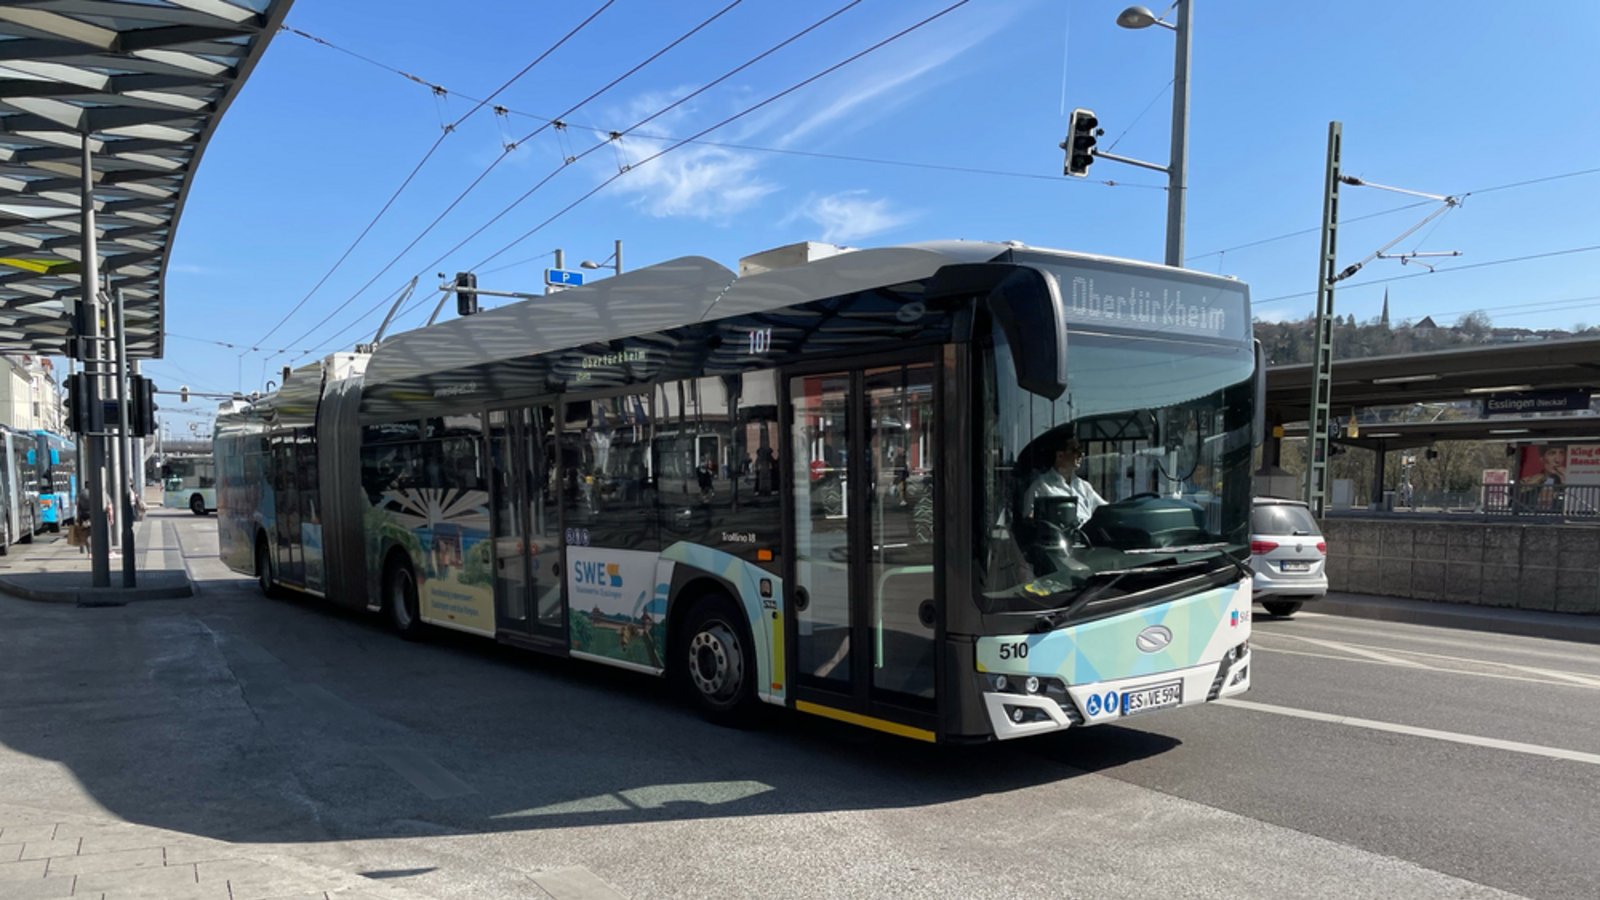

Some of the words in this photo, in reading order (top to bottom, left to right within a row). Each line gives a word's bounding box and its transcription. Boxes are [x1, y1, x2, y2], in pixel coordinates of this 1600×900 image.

[562, 272, 570, 283] P
[1072, 276, 1225, 330] Obertürkheim
[749, 328, 771, 354] 101
[1487, 399, 1535, 410] Esslingen
[575, 560, 606, 586] SWE
[999, 641, 1028, 660] 510
[1129, 693, 1143, 710] ES
[1148, 689, 1161, 705] VE
[1162, 686, 1179, 703] 594
